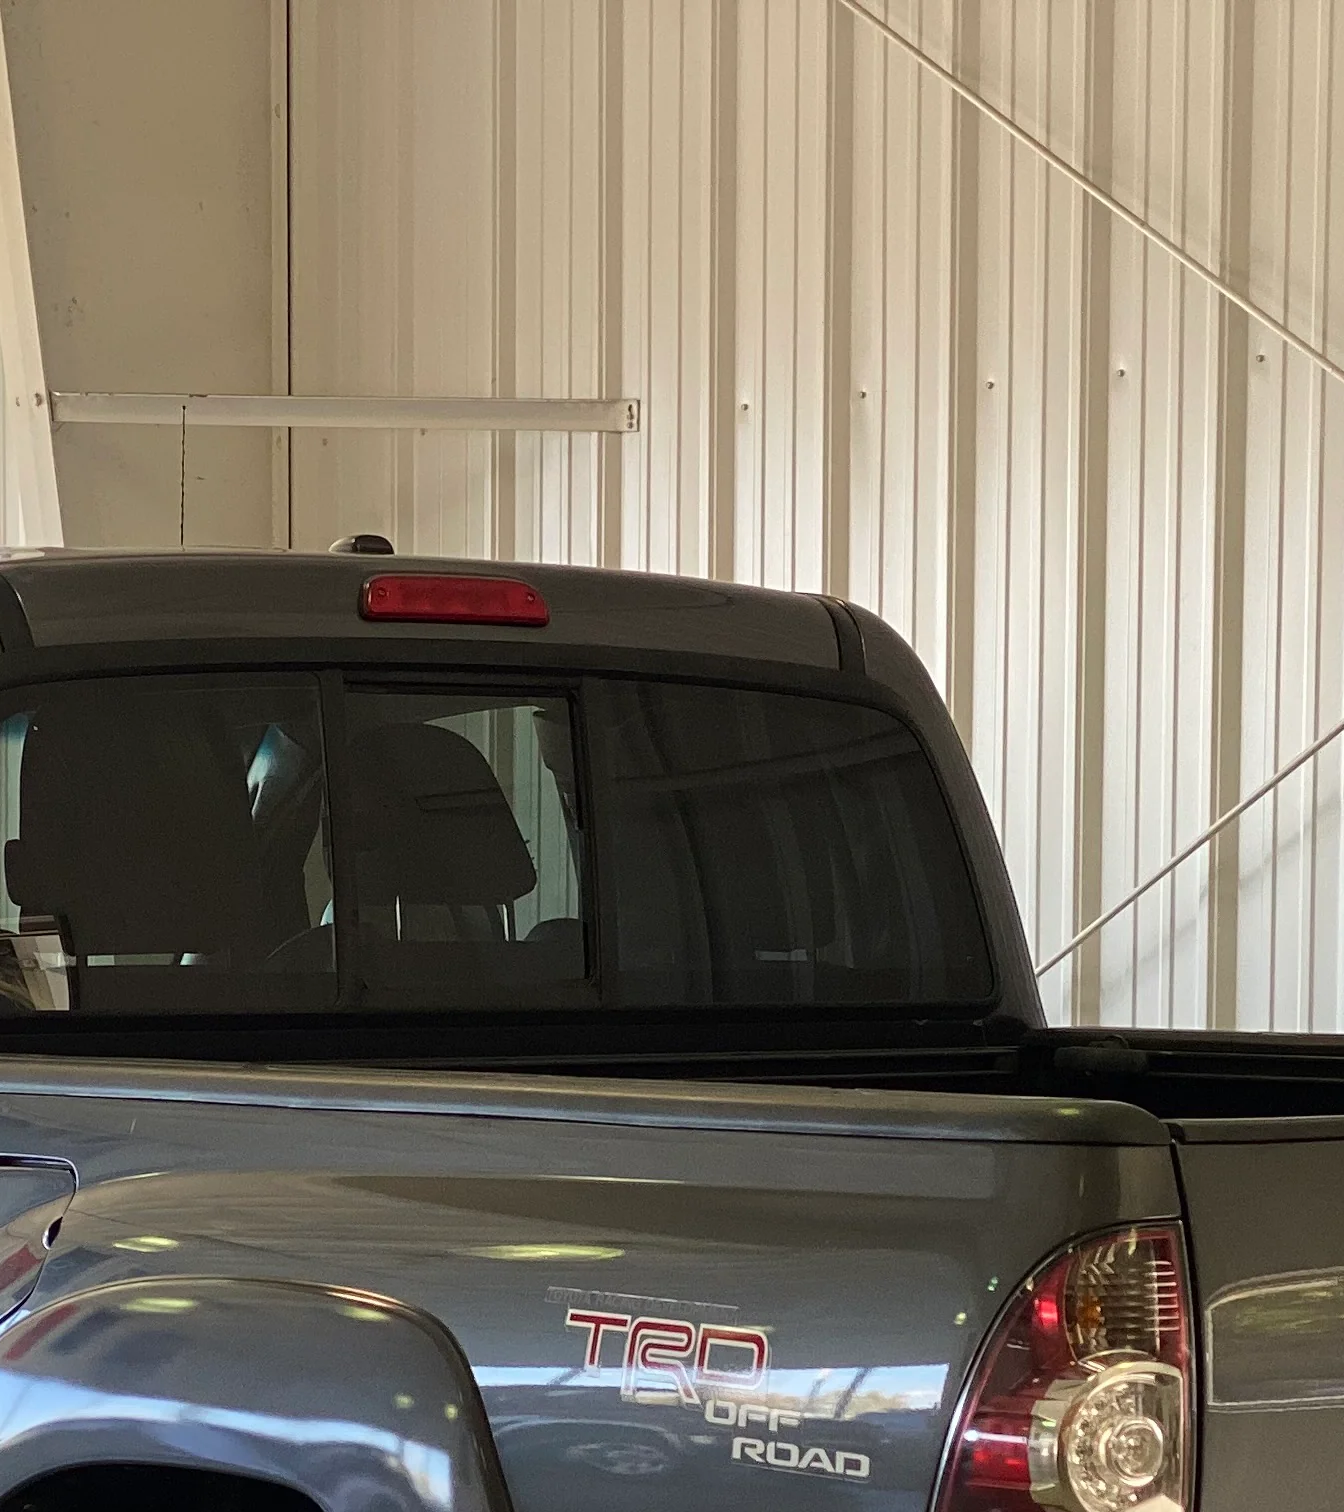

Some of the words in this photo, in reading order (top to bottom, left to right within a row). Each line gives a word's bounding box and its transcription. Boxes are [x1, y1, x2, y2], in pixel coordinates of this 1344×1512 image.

[565, 1307, 772, 1406] TRD
[704, 1397, 802, 1432] OFF
[730, 1435, 871, 1479] ROAD
